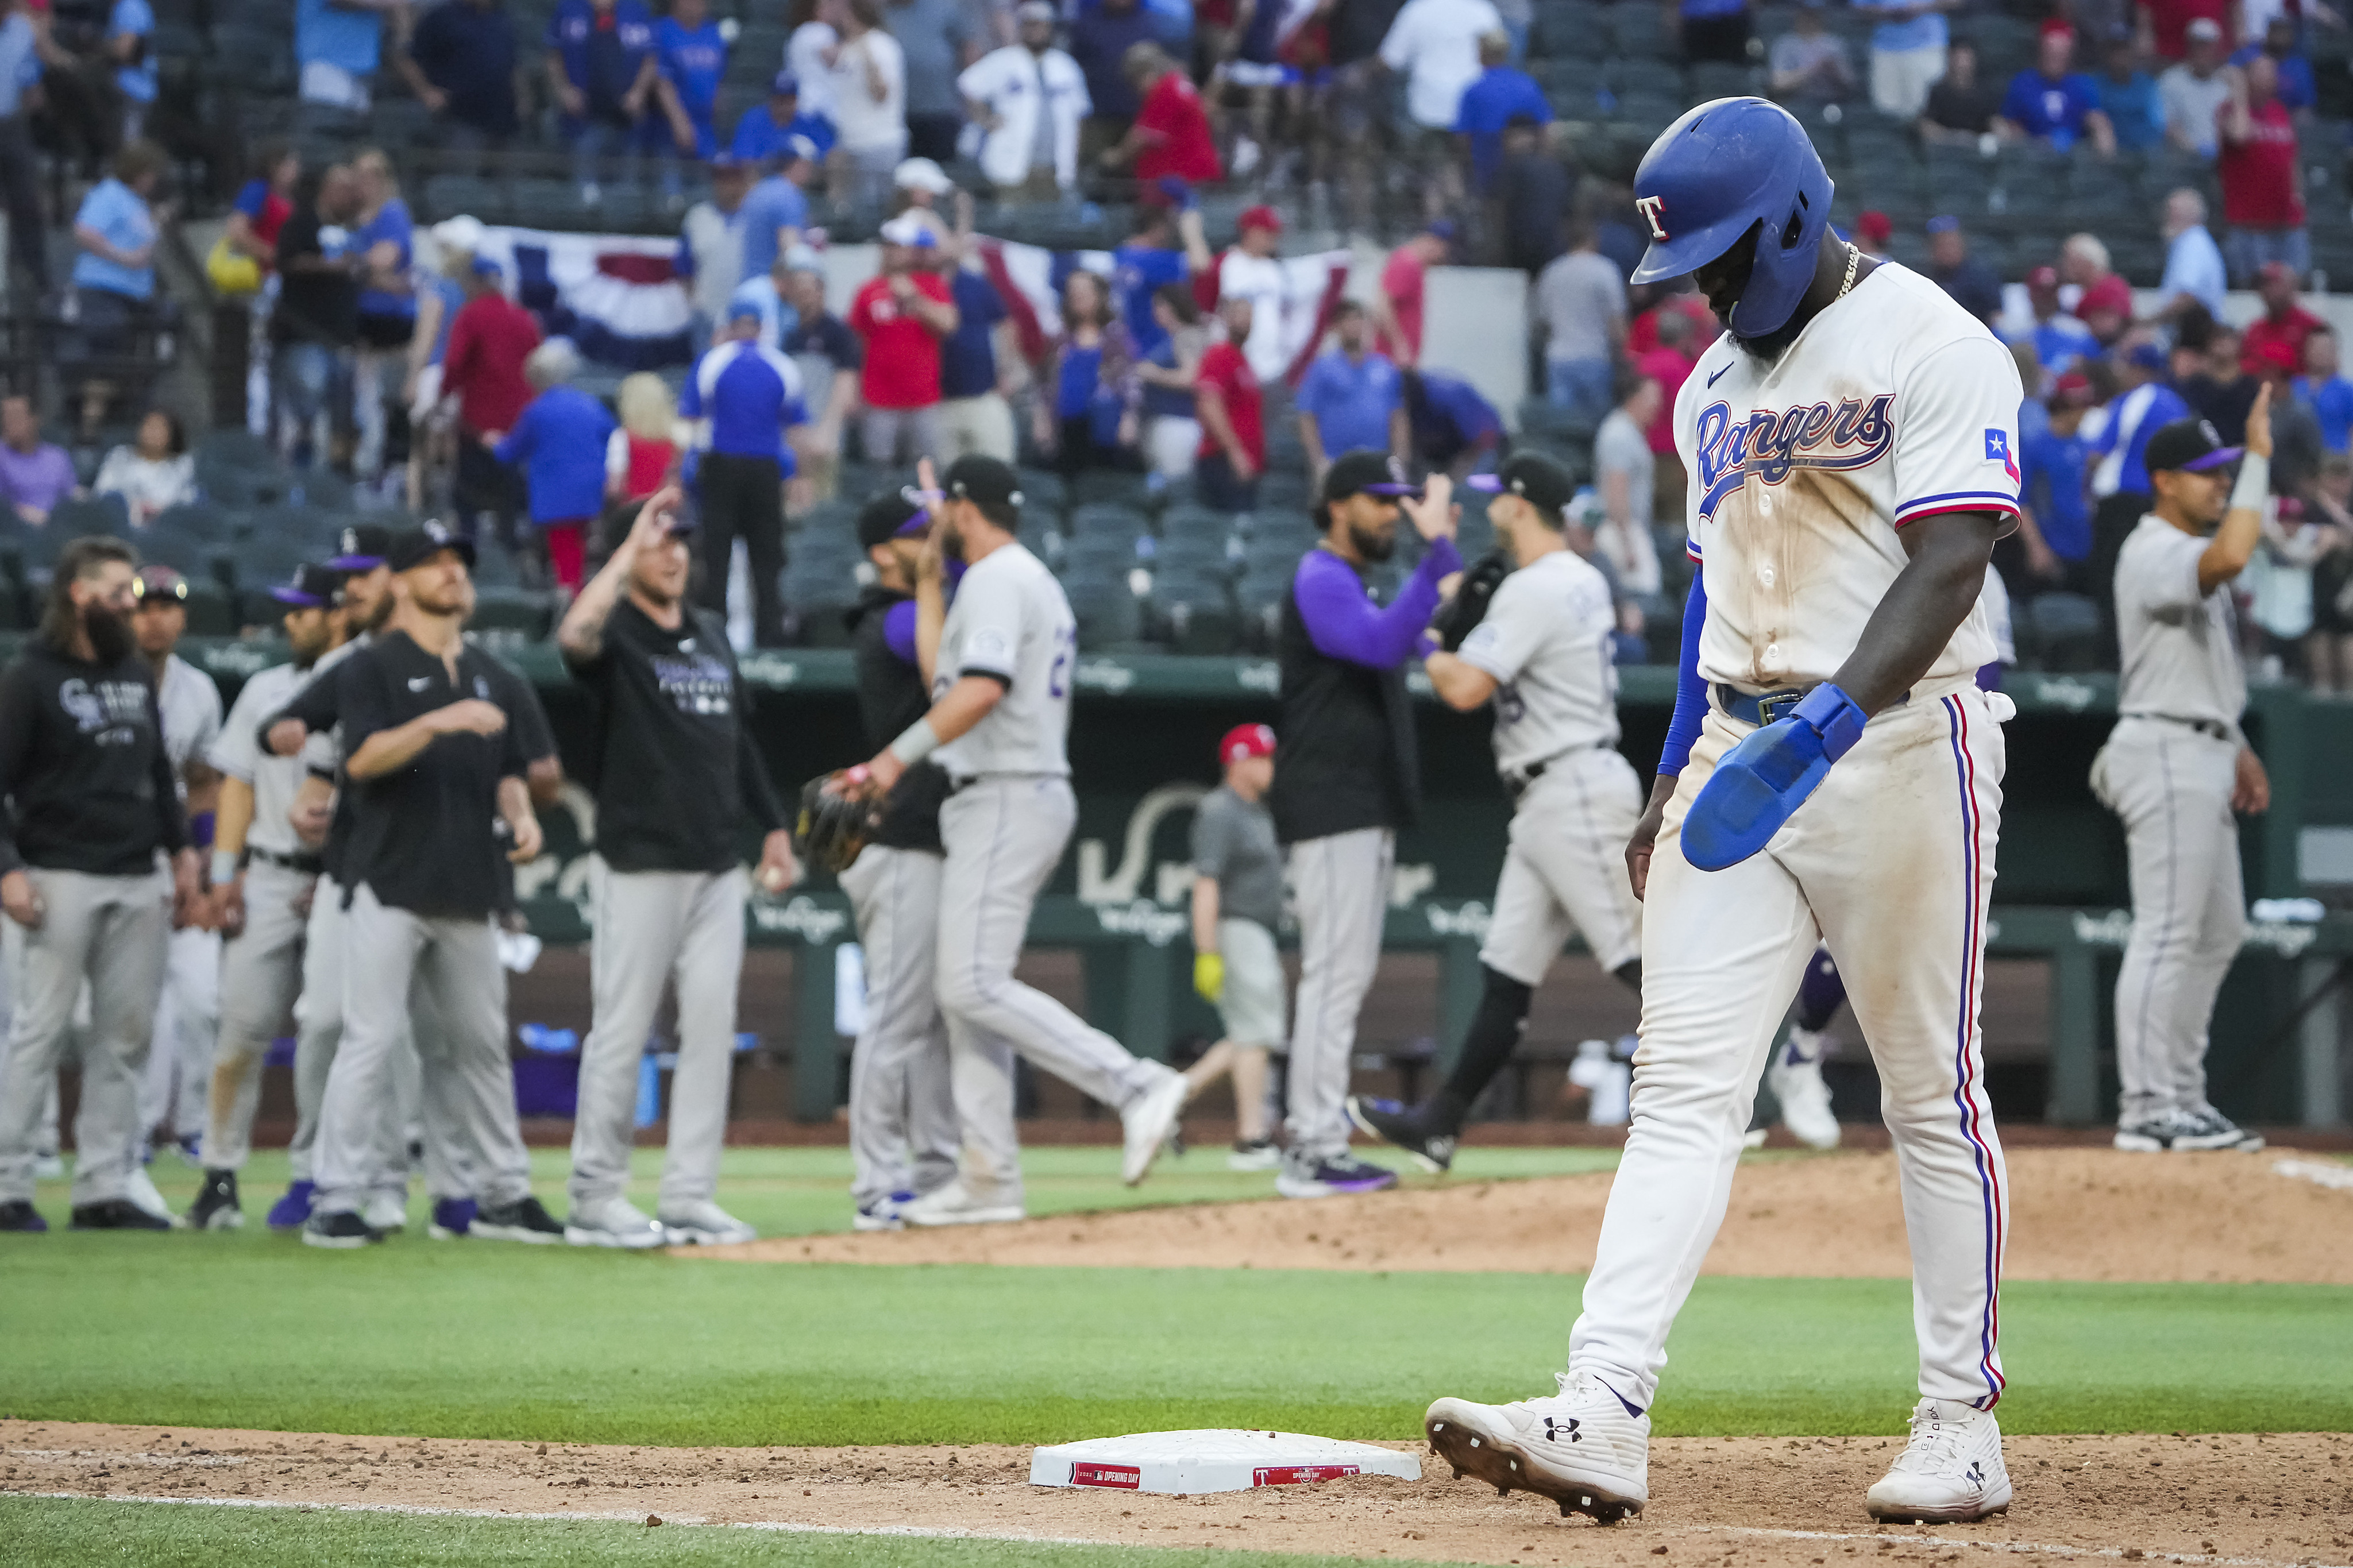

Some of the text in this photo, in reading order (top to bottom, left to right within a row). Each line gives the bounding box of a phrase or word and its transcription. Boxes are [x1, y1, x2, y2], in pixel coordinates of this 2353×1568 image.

[1635, 195, 1670, 241] T
[1696, 393, 1896, 494] Rangers
[1104, 1471, 1128, 1483] OPENING
[1128, 1473, 1140, 1484] DAY
[1256, 1469, 1268, 1486] T
